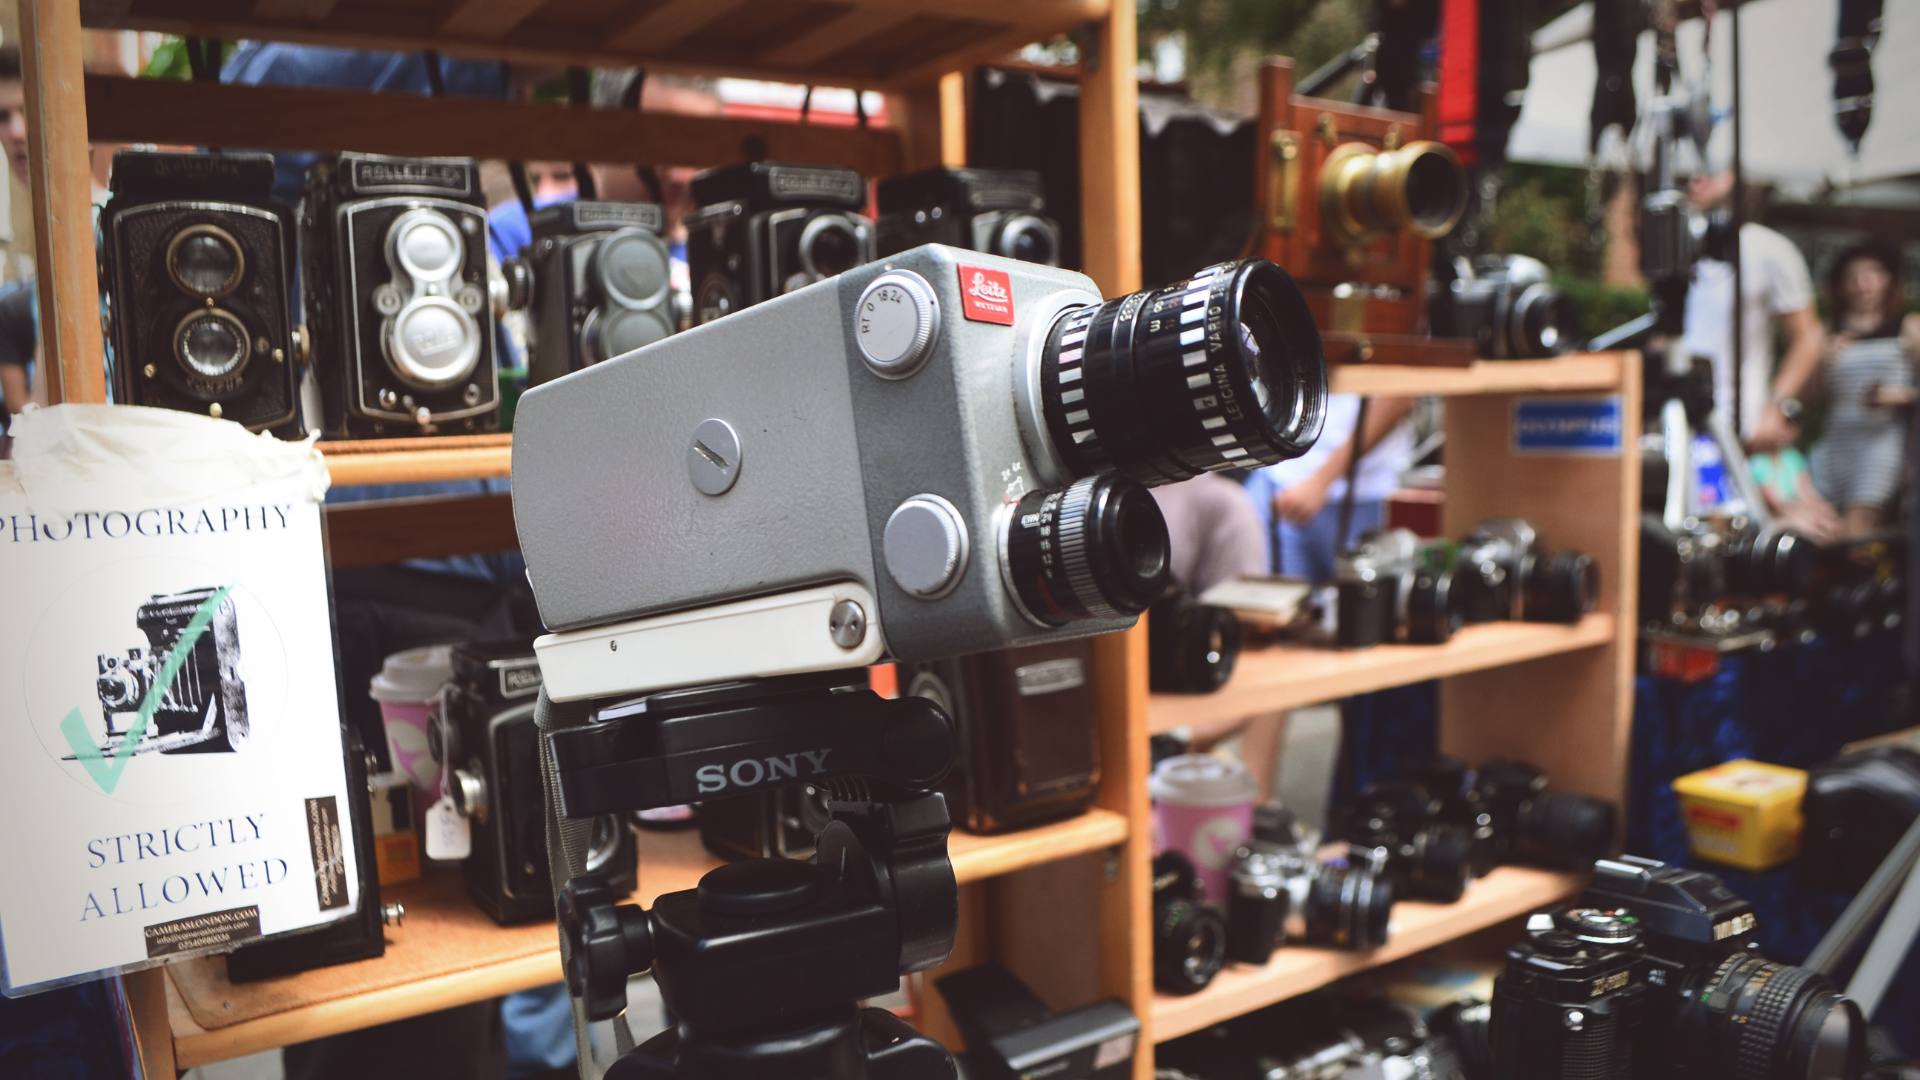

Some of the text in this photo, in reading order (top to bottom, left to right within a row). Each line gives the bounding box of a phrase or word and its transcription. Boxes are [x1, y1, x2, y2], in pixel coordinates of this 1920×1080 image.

[968, 271, 1009, 303] Leitz
[974, 300, 1009, 314] WETZLAR
[1207, 306, 1244, 421] LEICINA VARIO
[695, 748, 833, 794] SONY
[87, 813, 266, 869] STRICTLY
[79, 857, 288, 922] ALLOWED
[144, 908, 259, 938] CAMERASLONDON.COM
